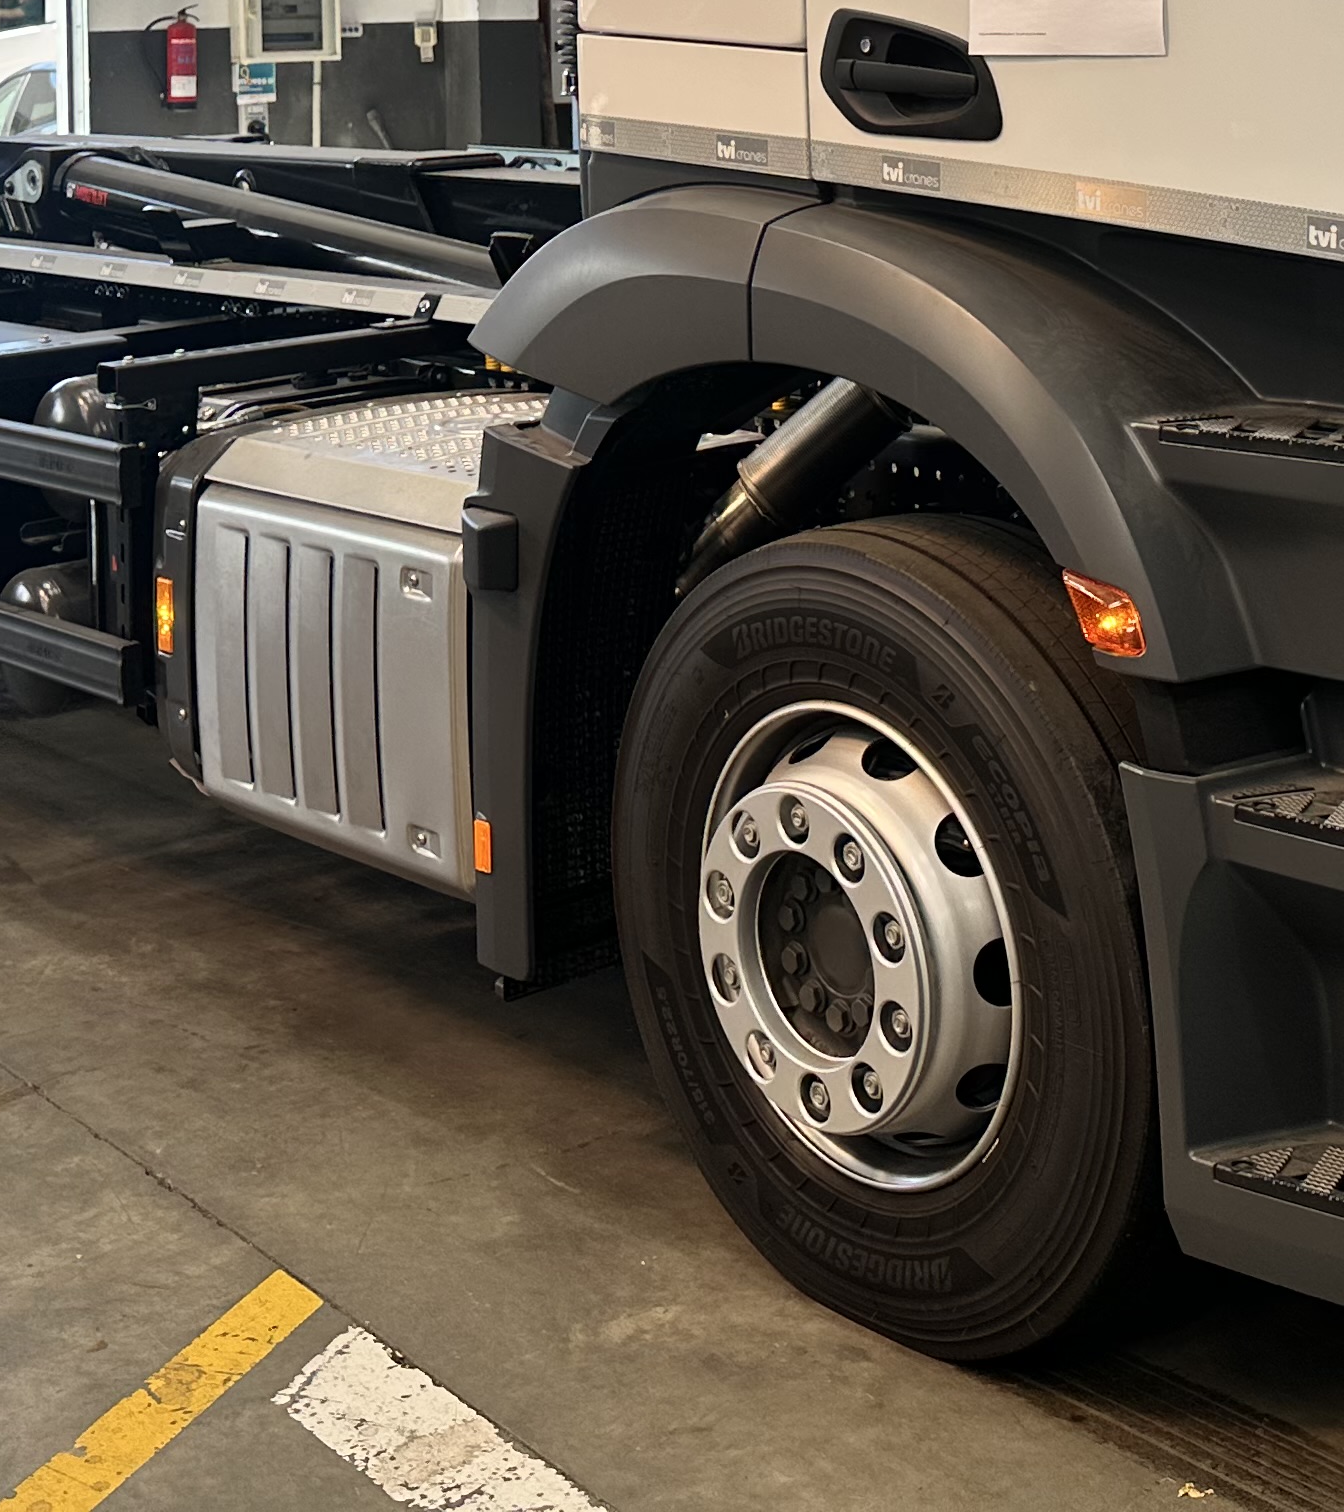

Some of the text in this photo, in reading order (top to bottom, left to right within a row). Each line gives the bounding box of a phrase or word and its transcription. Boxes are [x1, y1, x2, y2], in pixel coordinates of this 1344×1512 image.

[717, 139, 767, 164] tvi cranes
[882, 161, 939, 188] tvi cranes
[1077, 188, 1101, 213] tvi
[1307, 223, 1338, 249] tvi
[731, 615, 897, 674] BRIDGESTONE
[971, 734, 1051, 883] ECOPIA
[774, 1202, 953, 1294] BRIDGESTONE
